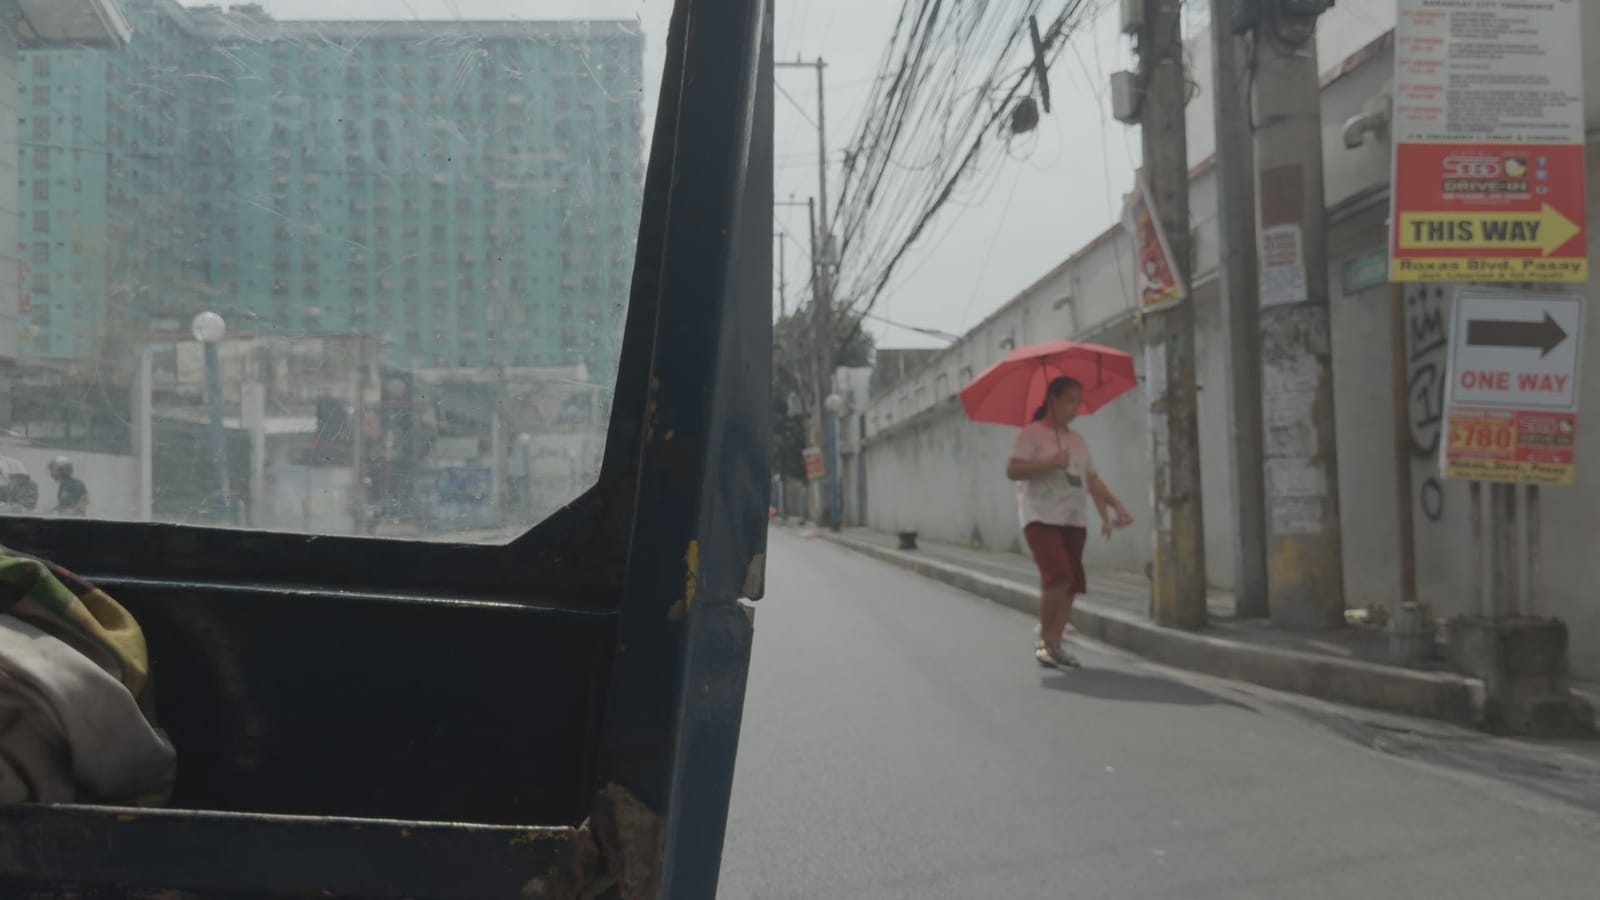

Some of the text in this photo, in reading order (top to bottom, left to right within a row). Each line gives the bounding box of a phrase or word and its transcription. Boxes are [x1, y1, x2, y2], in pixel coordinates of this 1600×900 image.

[1411, 220, 1541, 241] THIS WAY
[1400, 259, 1460, 270] Roxas
[1522, 259, 1581, 272] Pasay
[1460, 370, 1568, 394] ONE WAY
